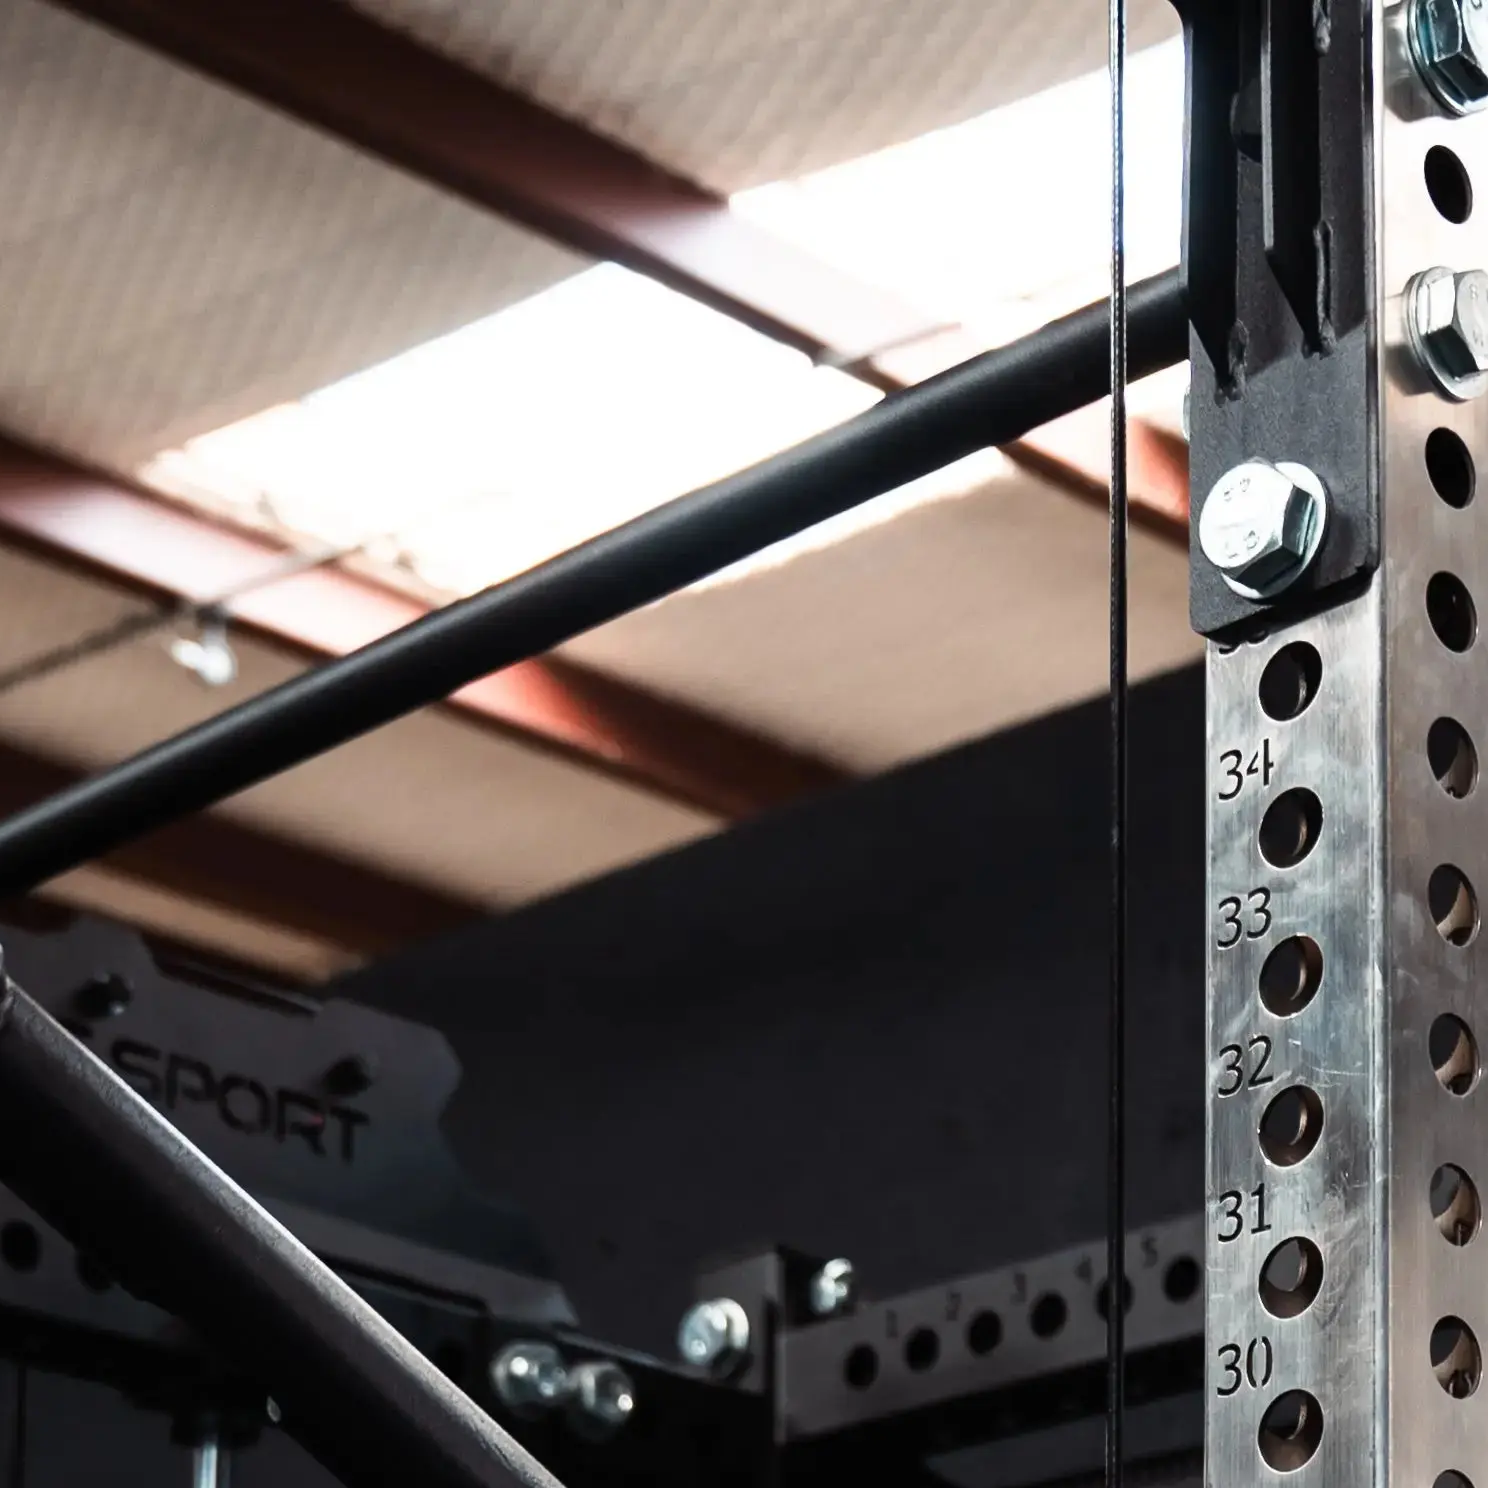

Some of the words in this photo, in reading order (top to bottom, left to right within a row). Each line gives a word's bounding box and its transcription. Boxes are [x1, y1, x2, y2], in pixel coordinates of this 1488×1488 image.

[1217, 738, 1274, 800] 34
[1216, 889, 1272, 949] 33
[1216, 1036, 1274, 1097] 32
[112, 1038, 369, 1162] SPORT
[1216, 1186, 1270, 1243] 31
[1216, 1336, 1272, 1397] 30
